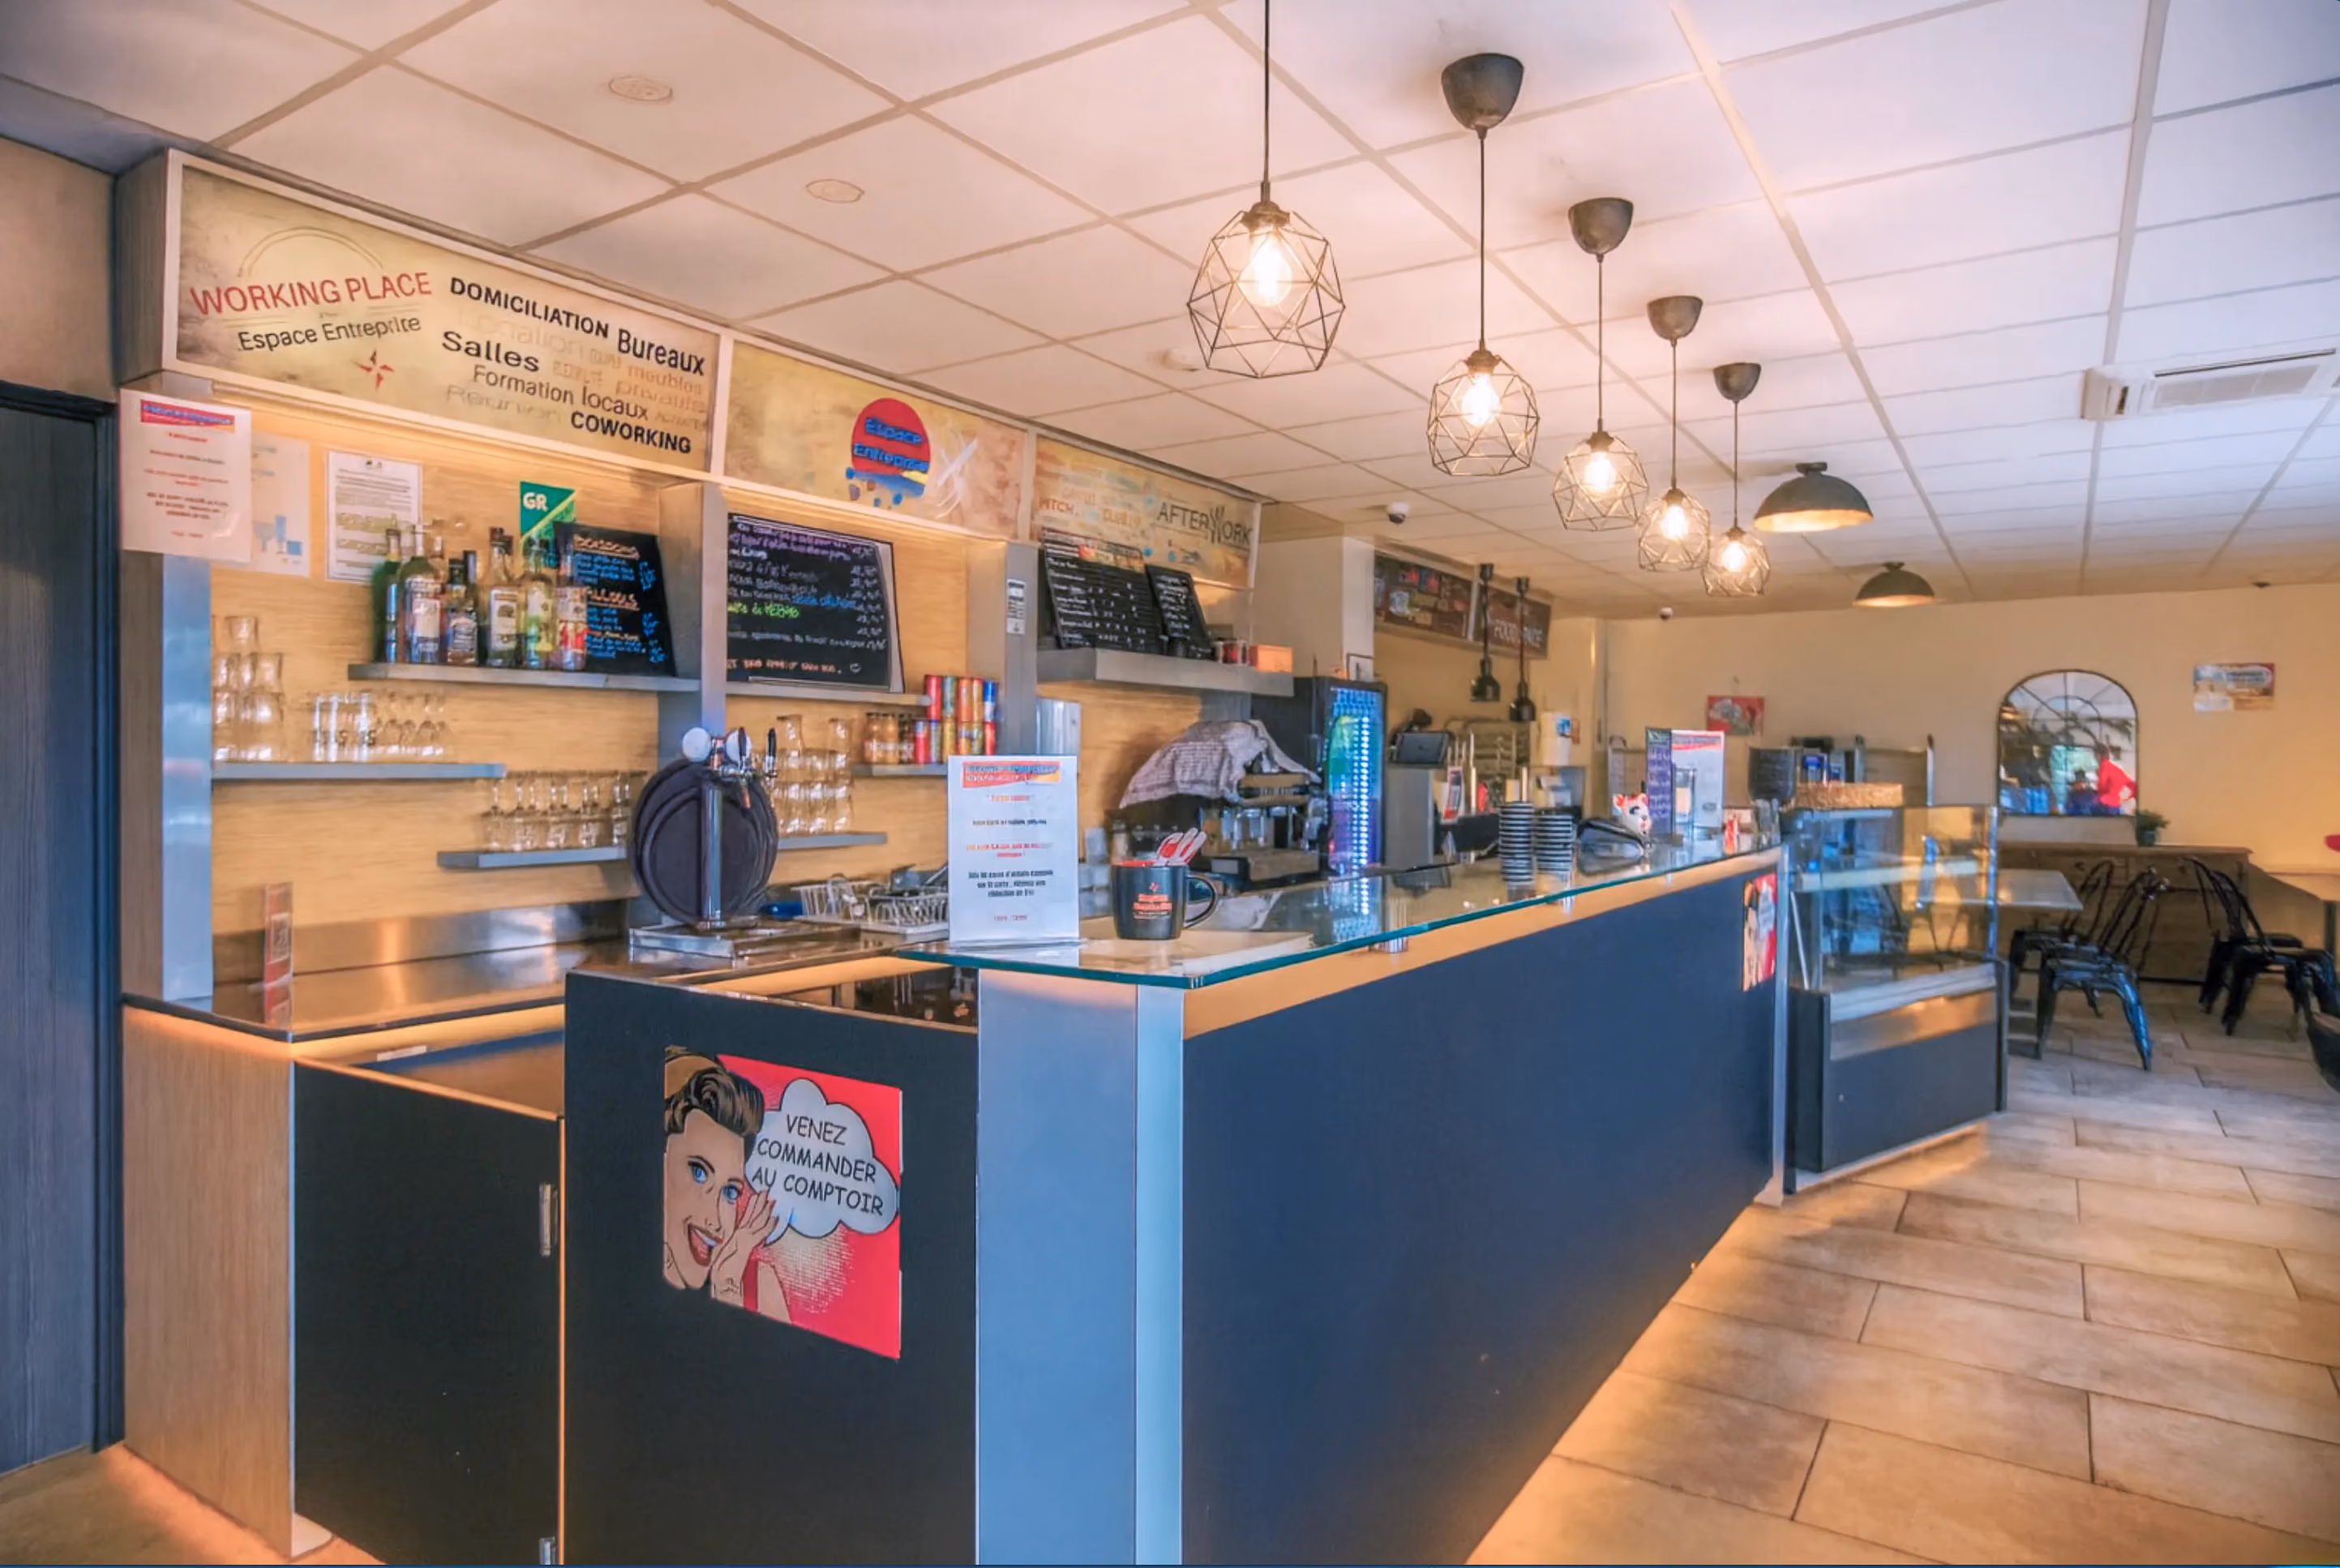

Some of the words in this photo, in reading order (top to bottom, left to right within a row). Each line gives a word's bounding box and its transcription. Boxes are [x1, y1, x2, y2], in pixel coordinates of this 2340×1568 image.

[189, 280, 341, 316] WORKING
[345, 272, 432, 302] PLACE
[238, 327, 318, 352] Espace
[450, 277, 609, 339] DOMICILIATION
[617, 328, 705, 375] Bureaux
[442, 330, 540, 373] Salles
[473, 364, 574, 405] Formation
[581, 386, 649, 422] locaux
[570, 411, 692, 455] COWORKING
[522, 492, 548, 512] GR
[786, 1113, 847, 1146] VENEZ
[757, 1138, 876, 1184] COMMANDER
[752, 1166, 777, 1188] AU
[783, 1174, 884, 1217] COMPTOIR
